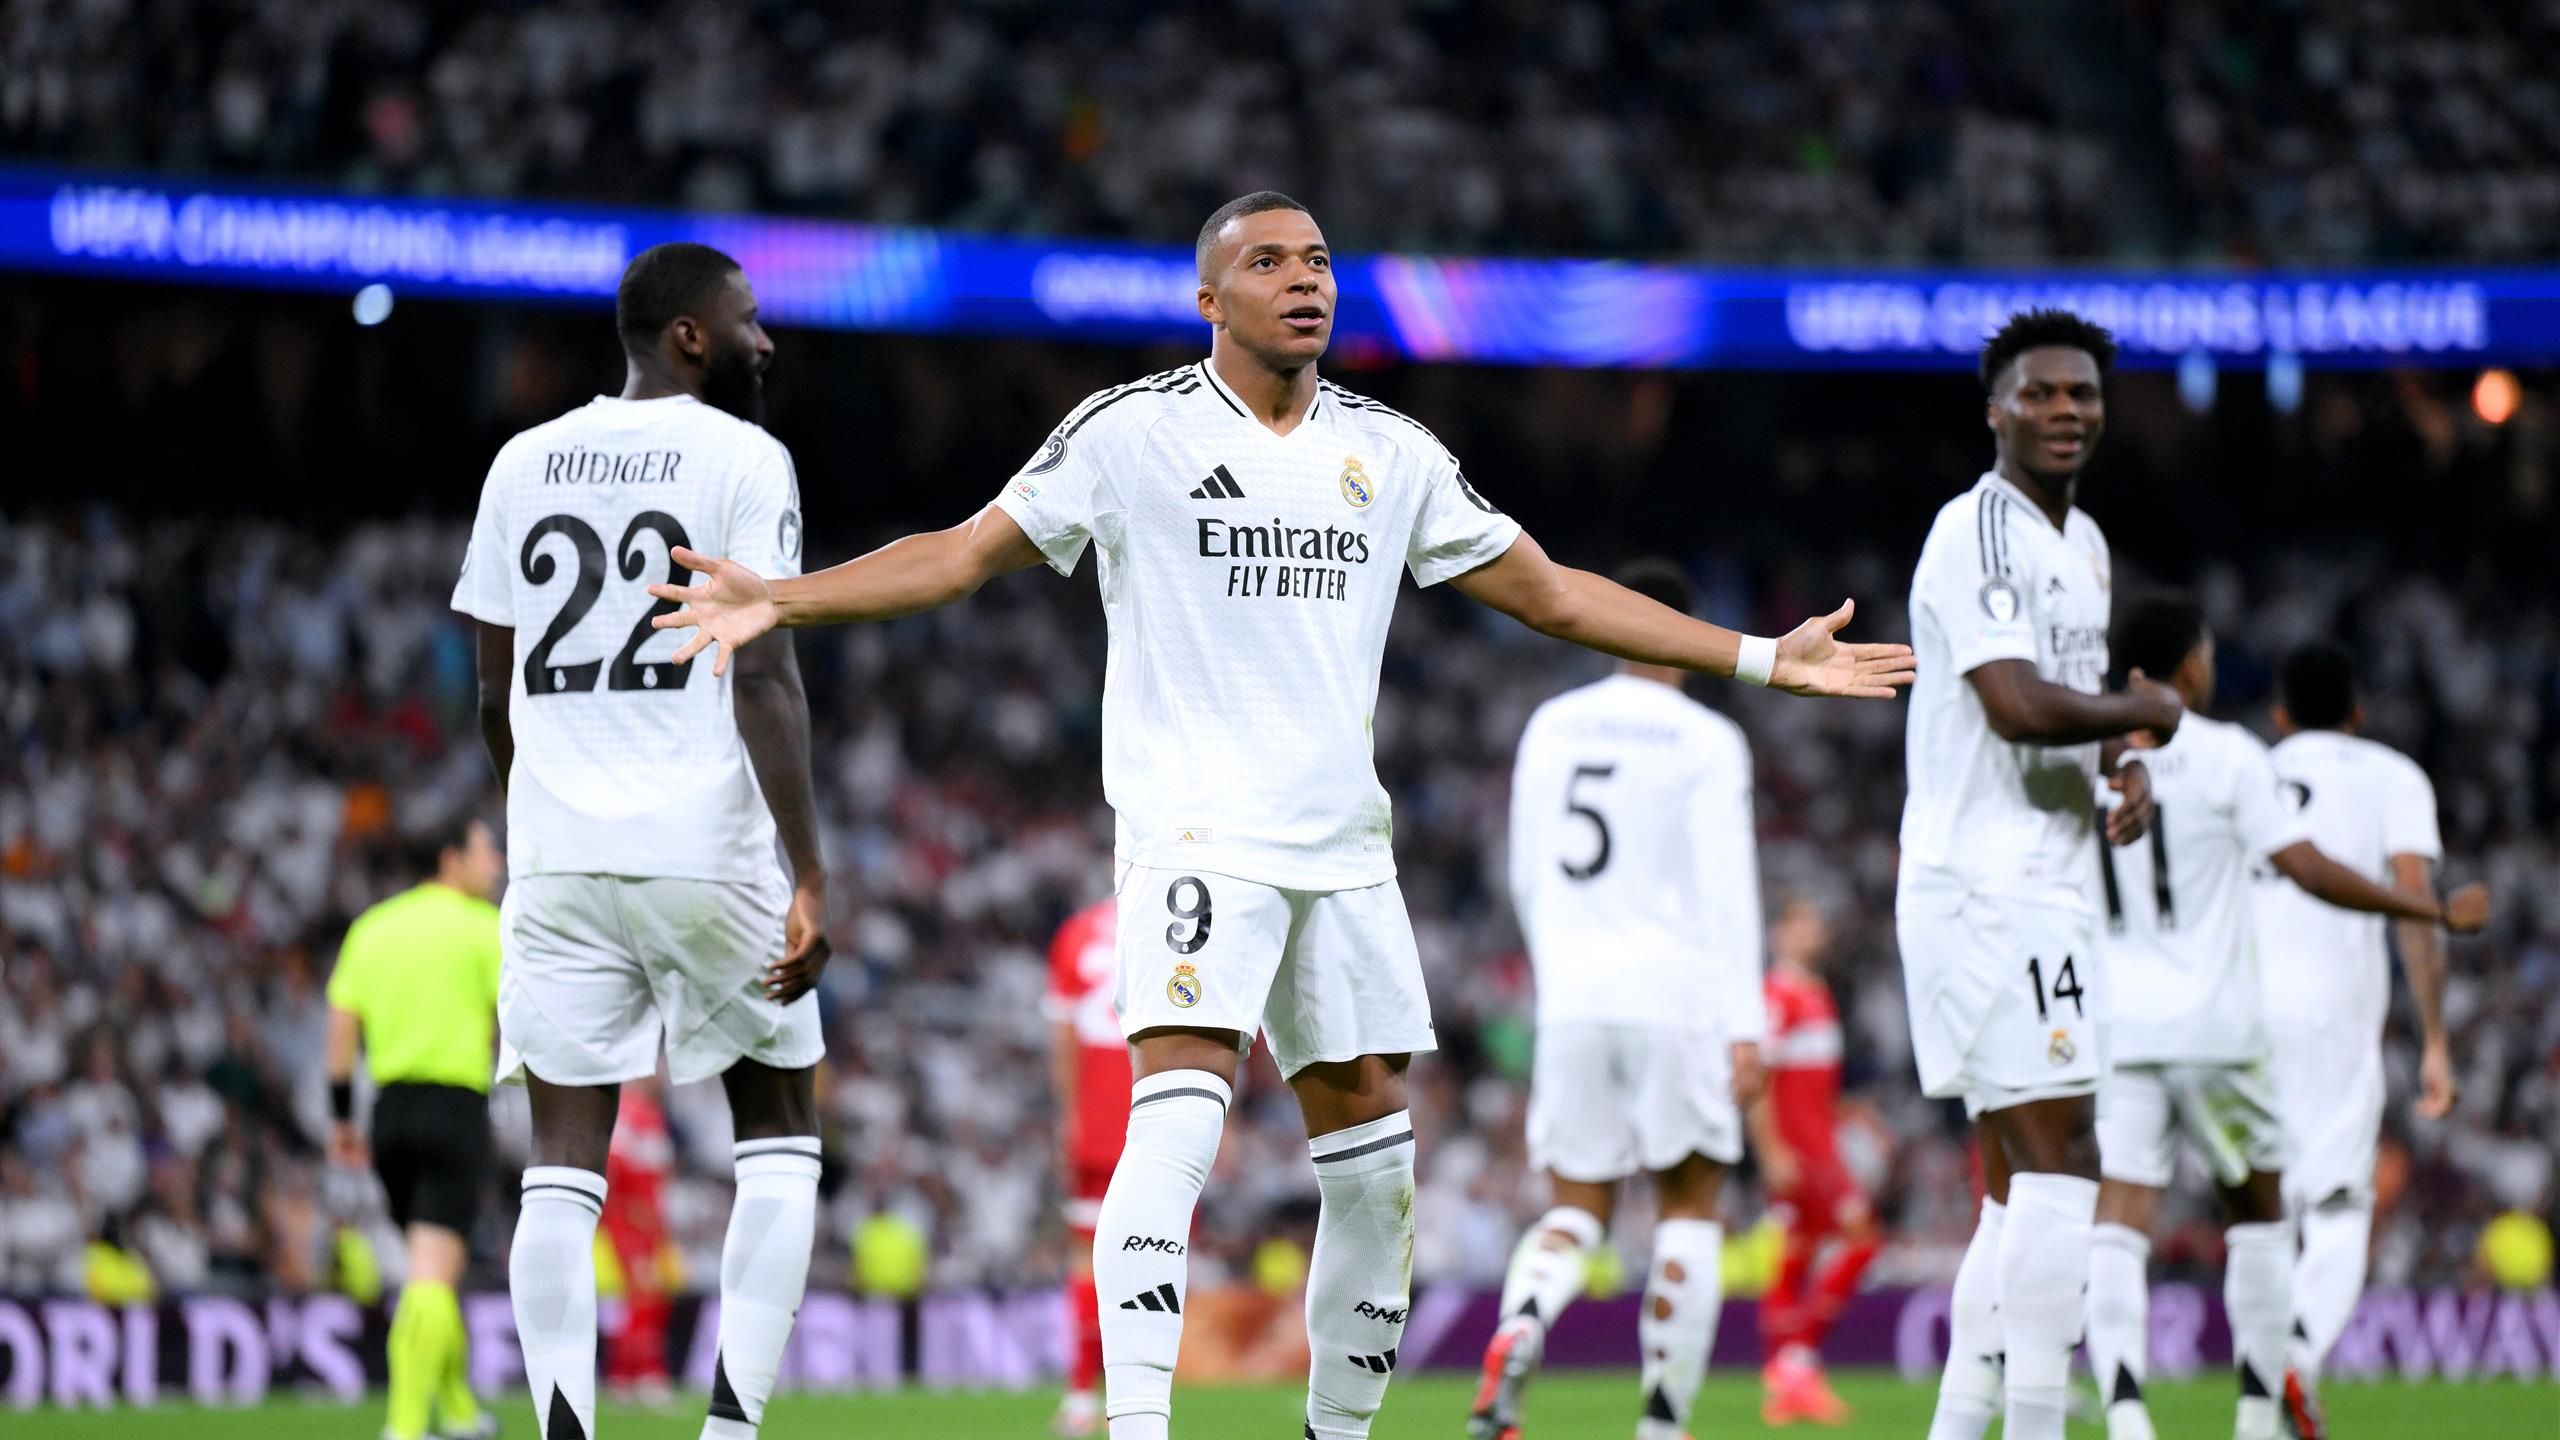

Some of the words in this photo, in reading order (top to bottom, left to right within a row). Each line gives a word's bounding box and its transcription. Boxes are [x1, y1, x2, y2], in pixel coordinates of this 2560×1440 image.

[545, 444, 682, 485] RÜDIGER
[1196, 517, 1369, 564] Emirates
[520, 510, 693, 697] 22
[1227, 565, 1268, 597] FLY
[1276, 565, 1347, 601] BETTER
[1560, 764, 1616, 882] 5
[2095, 801, 2179, 937] 11
[1166, 876, 1212, 955] 9
[2027, 953, 2084, 1024] 14
